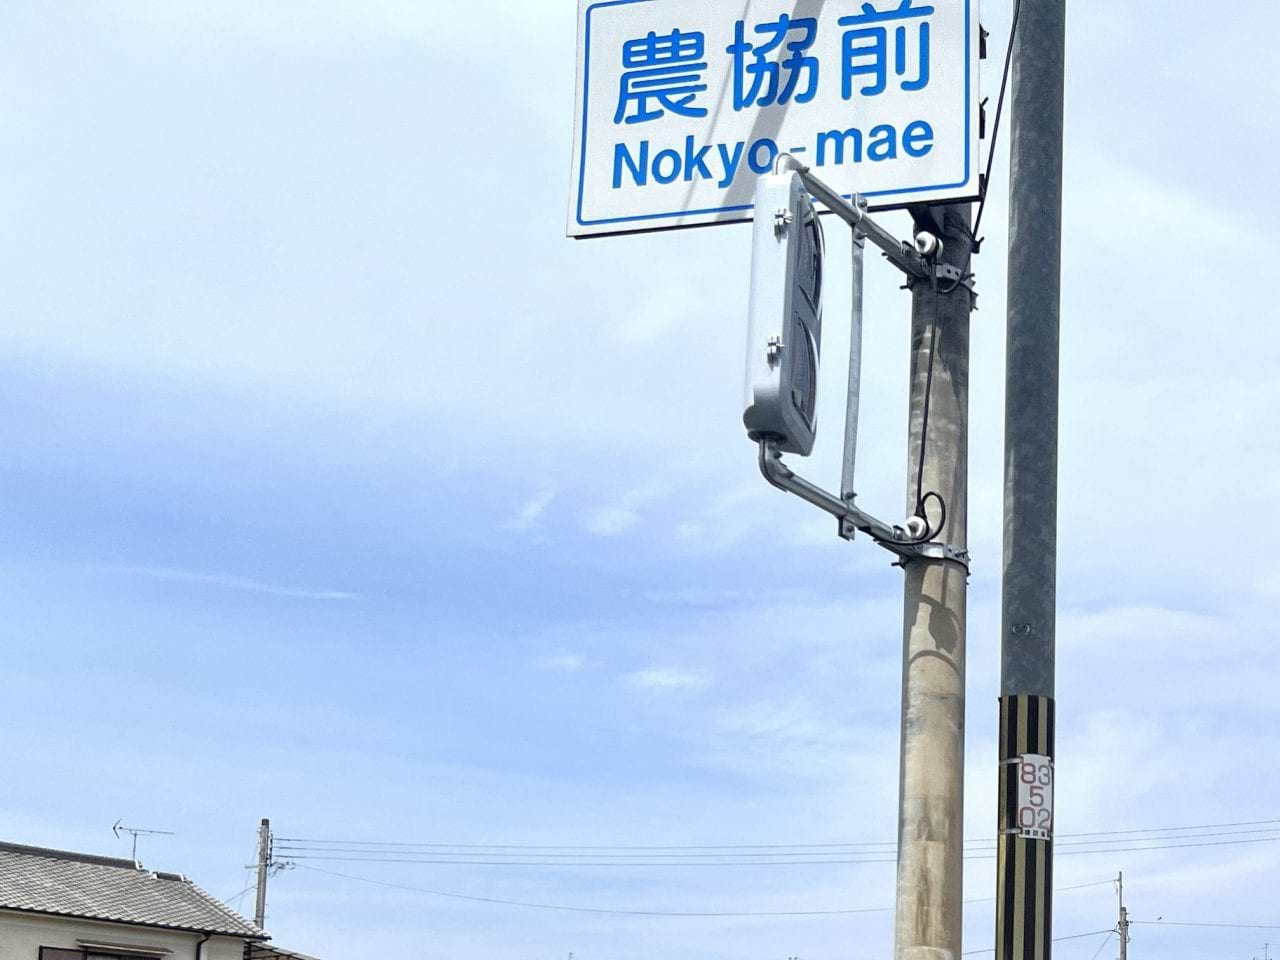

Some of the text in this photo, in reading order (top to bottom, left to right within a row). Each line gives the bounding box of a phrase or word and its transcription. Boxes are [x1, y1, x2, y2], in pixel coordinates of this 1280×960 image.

[613, 0, 934, 125] 農協前
[612, 119, 934, 189] Nokyo-mae
